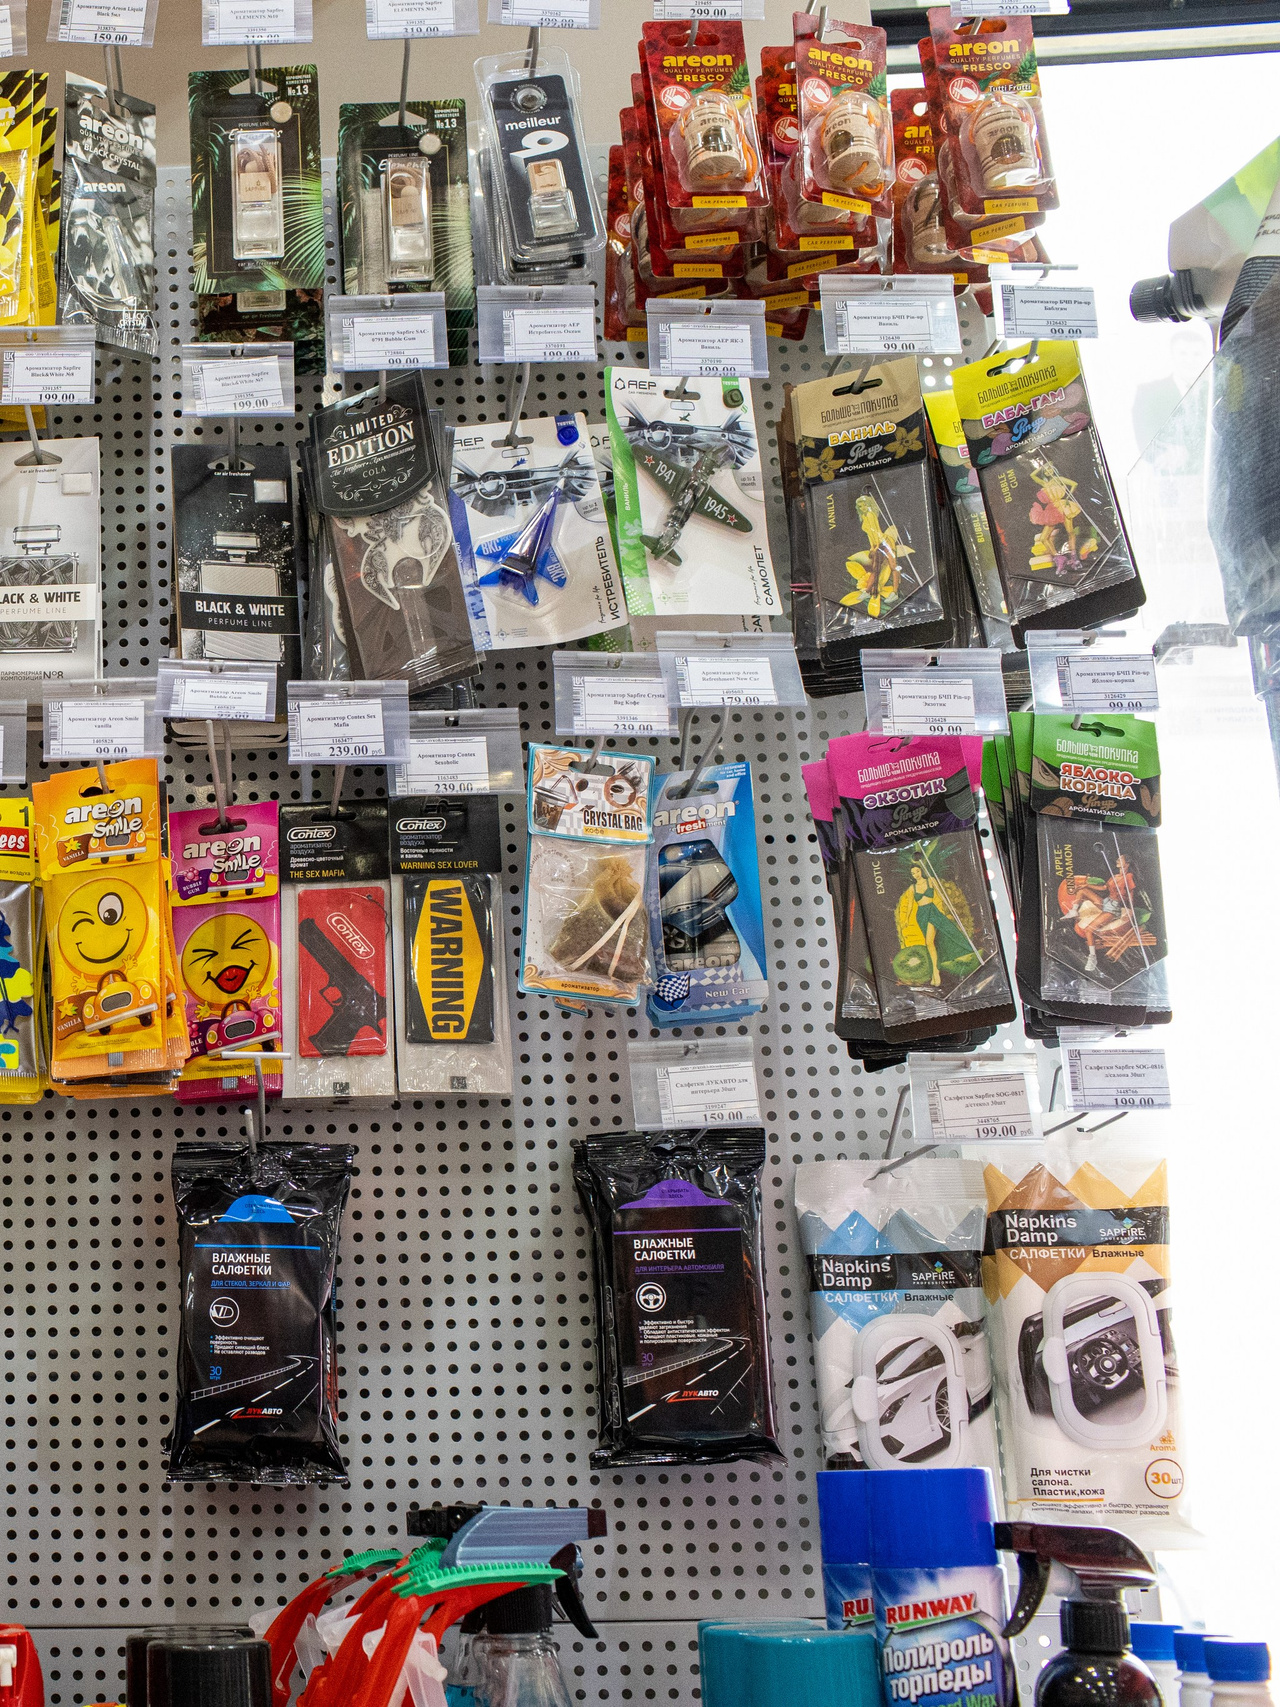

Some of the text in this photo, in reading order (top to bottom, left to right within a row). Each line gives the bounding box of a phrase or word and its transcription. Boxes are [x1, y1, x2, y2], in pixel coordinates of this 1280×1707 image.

[690, 8, 727, 18] 299.00
[93, 34, 128, 43] 159.00
[963, 61, 1011, 73] FRESCO
[676, 74, 724, 82] FRESCO
[820, 69, 863, 84] FRESCO
[505, 116, 561, 130] meilleur
[38, 393, 75, 403] 199.00
[233, 399, 269, 410] 199.00
[982, 387, 1065, 428] БАБЛ-ГАМ
[828, 421, 895, 447] ВАНИЛЬ
[1005, 429, 1058, 452] АРОМАТИЗАТОР
[327, 422, 414, 468] EDITION
[653, 461, 676, 483] 1941
[840, 458, 892, 473] АРОМАТИЗАТОР
[704, 499, 727, 519] 1945
[30, 593, 38, 603] &
[44, 592, 80, 602] WHITE
[196, 602, 284, 616] BLACK & WHITE
[209, 617, 272, 627] PERFUME LINE
[720, 696, 760, 705] 179.00
[329, 745, 369, 757] 239.00
[1061, 762, 1141, 786] ЯБЛОКО-
[434, 782, 474, 793] 239.00
[864, 778, 946, 810] ЭКЗОТИК
[1061, 778, 1135, 800] КОРИЦА
[583, 810, 642, 831] CRYSTAL BAG
[401, 860, 479, 870] WARNING SEX LOVER
[305, 870, 320, 878] SEX
[323, 869, 345, 877] MAFIA
[876, 861, 884, 895] EXOTIC
[429, 885, 465, 1034] WARNING
[703, 1111, 743, 1122] 159.00
[975, 1125, 1017, 1138] 199.00
[1005, 1213, 1077, 1230] Napkins
[1006, 1228, 1058, 1244] Damp
[634, 1238, 693, 1249] ВЛАЖНЫЕ
[213, 1253, 270, 1264] ВЛАЖНЫЕ
[634, 1249, 696, 1261] САЛФЕТКИ
[1009, 1247, 1144, 1260] САЛФЕТКИ Влажные
[212, 1265, 272, 1276] САЛФЕТКИ
[822, 1259, 891, 1275] Napkins
[823, 1273, 872, 1289] Damp
[826, 1292, 954, 1303] САЛФЕТКИ Влажные
[209, 1367, 222, 1376] 30
[1149, 1443, 1177, 1452] Aroma
[1031, 1468, 1091, 1478] Для чистки
[1032, 1478, 1072, 1487] салона.
[886, 1593, 976, 1625] RUNWAY
[883, 1635, 994, 1675] Полироль
[890, 1661, 992, 1703] торпеды
